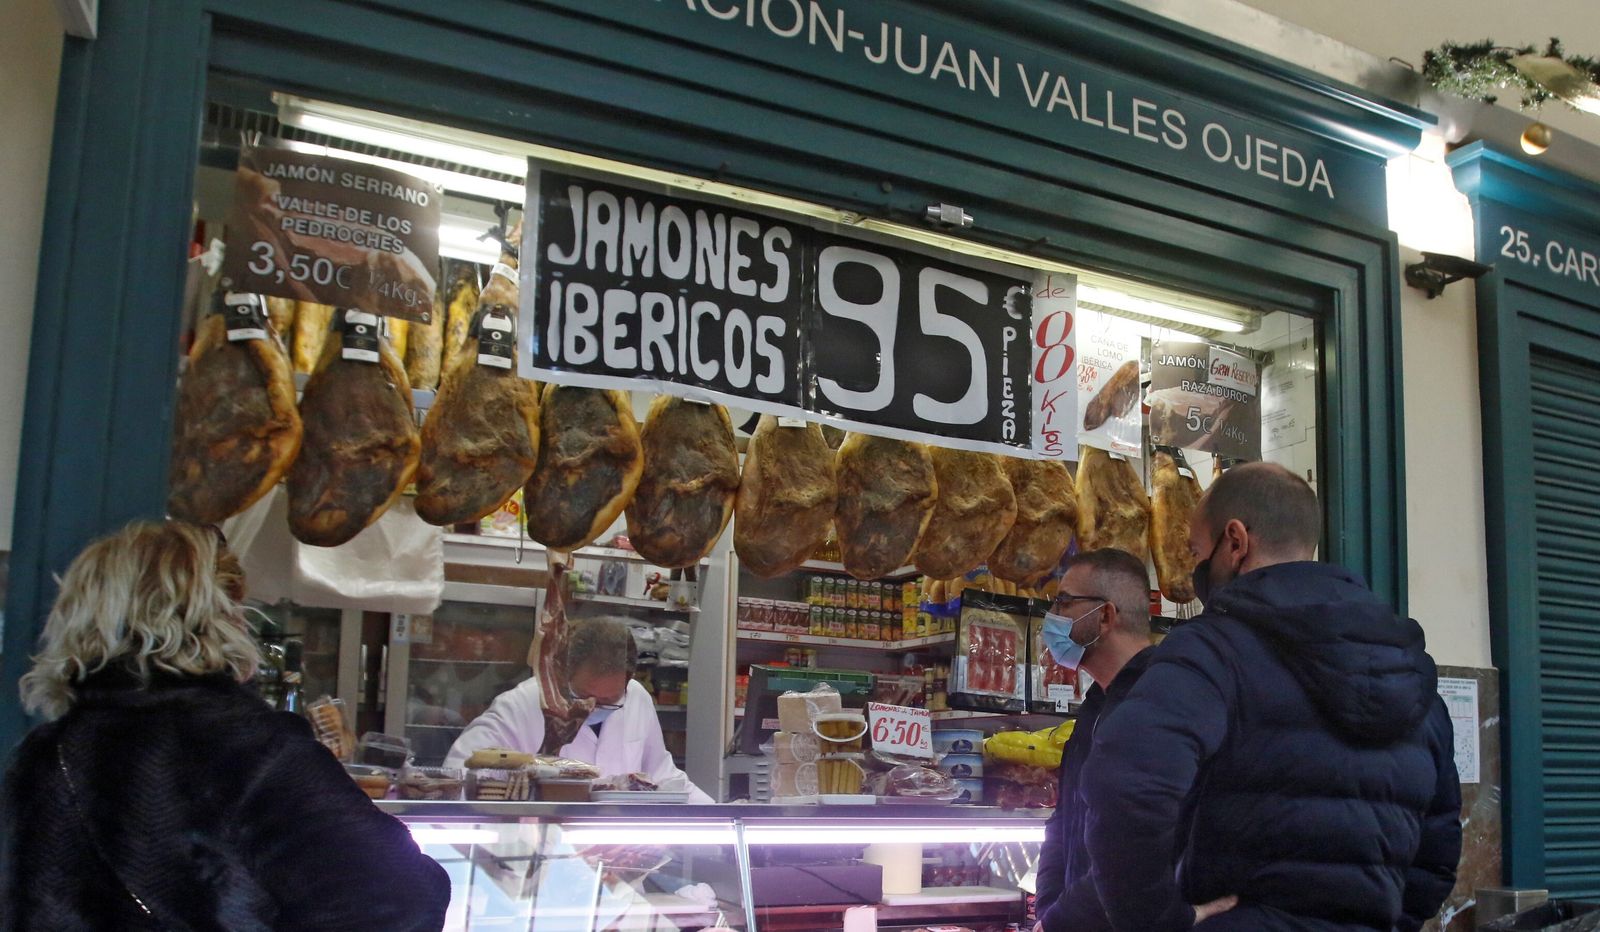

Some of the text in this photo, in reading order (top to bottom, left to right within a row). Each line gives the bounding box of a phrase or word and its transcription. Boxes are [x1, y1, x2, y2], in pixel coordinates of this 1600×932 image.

[1017, 63, 1188, 150] VALLES
[1202, 123, 1335, 199] OJEDA
[264, 163, 428, 207] JAMÓN SERRANO
[278, 194, 412, 234] VALLE DE LOS
[281, 217, 404, 253] PEDROCHES
[547, 185, 793, 303] JAMONES
[1546, 240, 1600, 287] CAR
[1036, 276, 1071, 299] de
[817, 245, 989, 425] 95
[1034, 311, 1074, 384] 8
[1159, 355, 1206, 369] JAMÓN
[1181, 380, 1248, 404] RAZA DUROC
